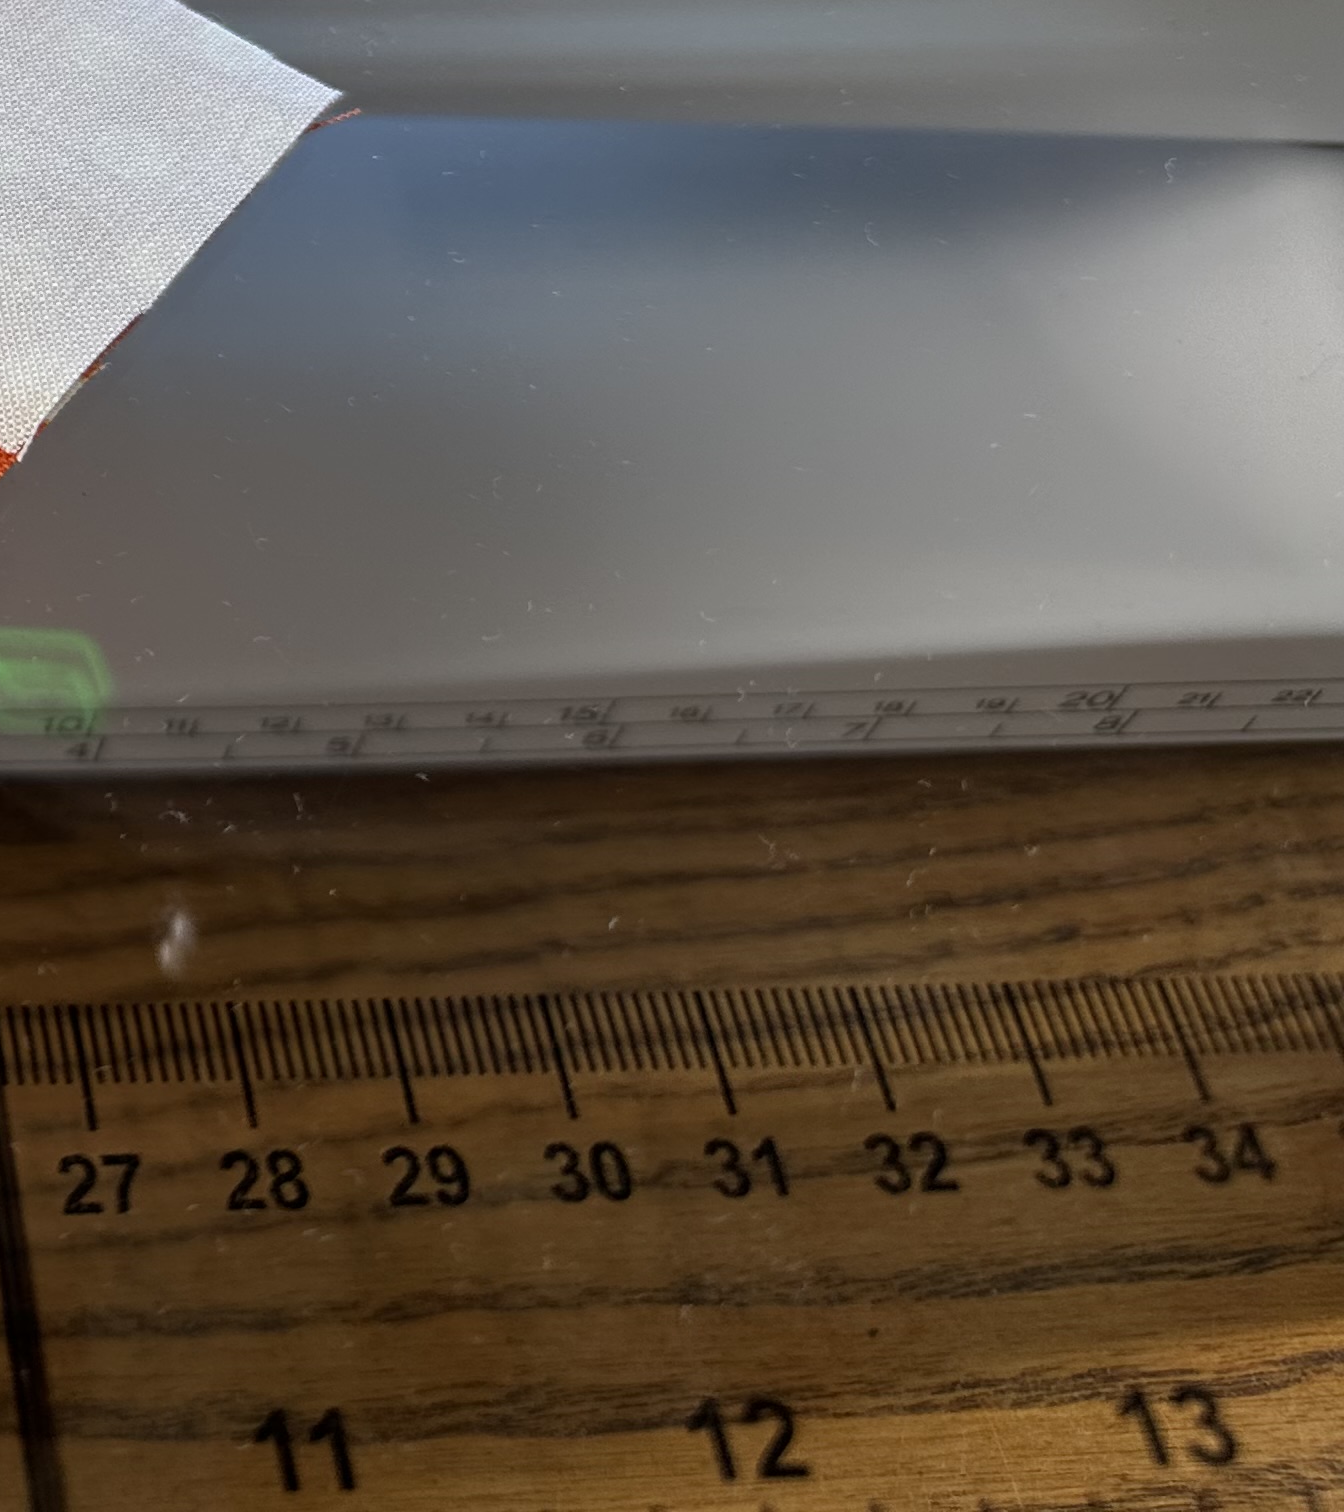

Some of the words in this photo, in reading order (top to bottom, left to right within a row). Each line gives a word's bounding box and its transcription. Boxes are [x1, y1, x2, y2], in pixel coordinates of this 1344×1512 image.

[41, 716, 83, 734] 10
[1057, 690, 1114, 709] 20
[1175, 691, 1211, 706] 21
[58, 1153, 141, 1217] 27
[219, 1148, 309, 1211] 28
[382, 1145, 471, 1207] 29
[543, 1140, 633, 1203] 30
[703, 1136, 790, 1199] 31
[863, 1131, 960, 1195] 32
[1023, 1125, 1117, 1190] 33
[1182, 1120, 1277, 1186] 34
[254, 1406, 354, 1491] 11
[688, 1395, 811, 1480] 12
[1120, 1382, 1239, 1467] 13
